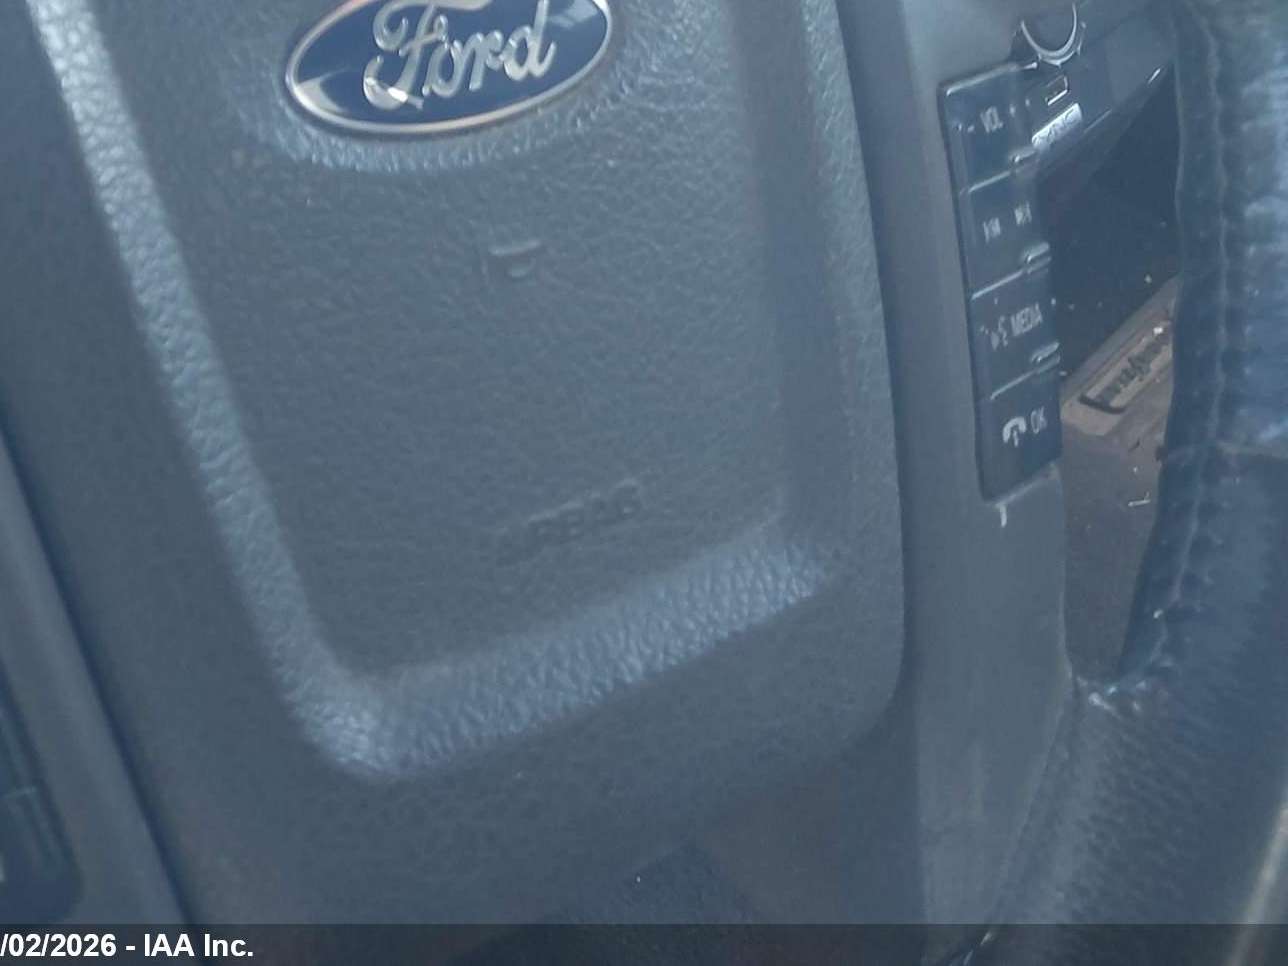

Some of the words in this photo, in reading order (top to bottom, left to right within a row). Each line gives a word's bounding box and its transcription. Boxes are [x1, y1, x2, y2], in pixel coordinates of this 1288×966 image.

[980, 106, 1003, 133] VOL
[1011, 303, 1043, 337] MEDIA
[1031, 407, 1047, 434] OK
